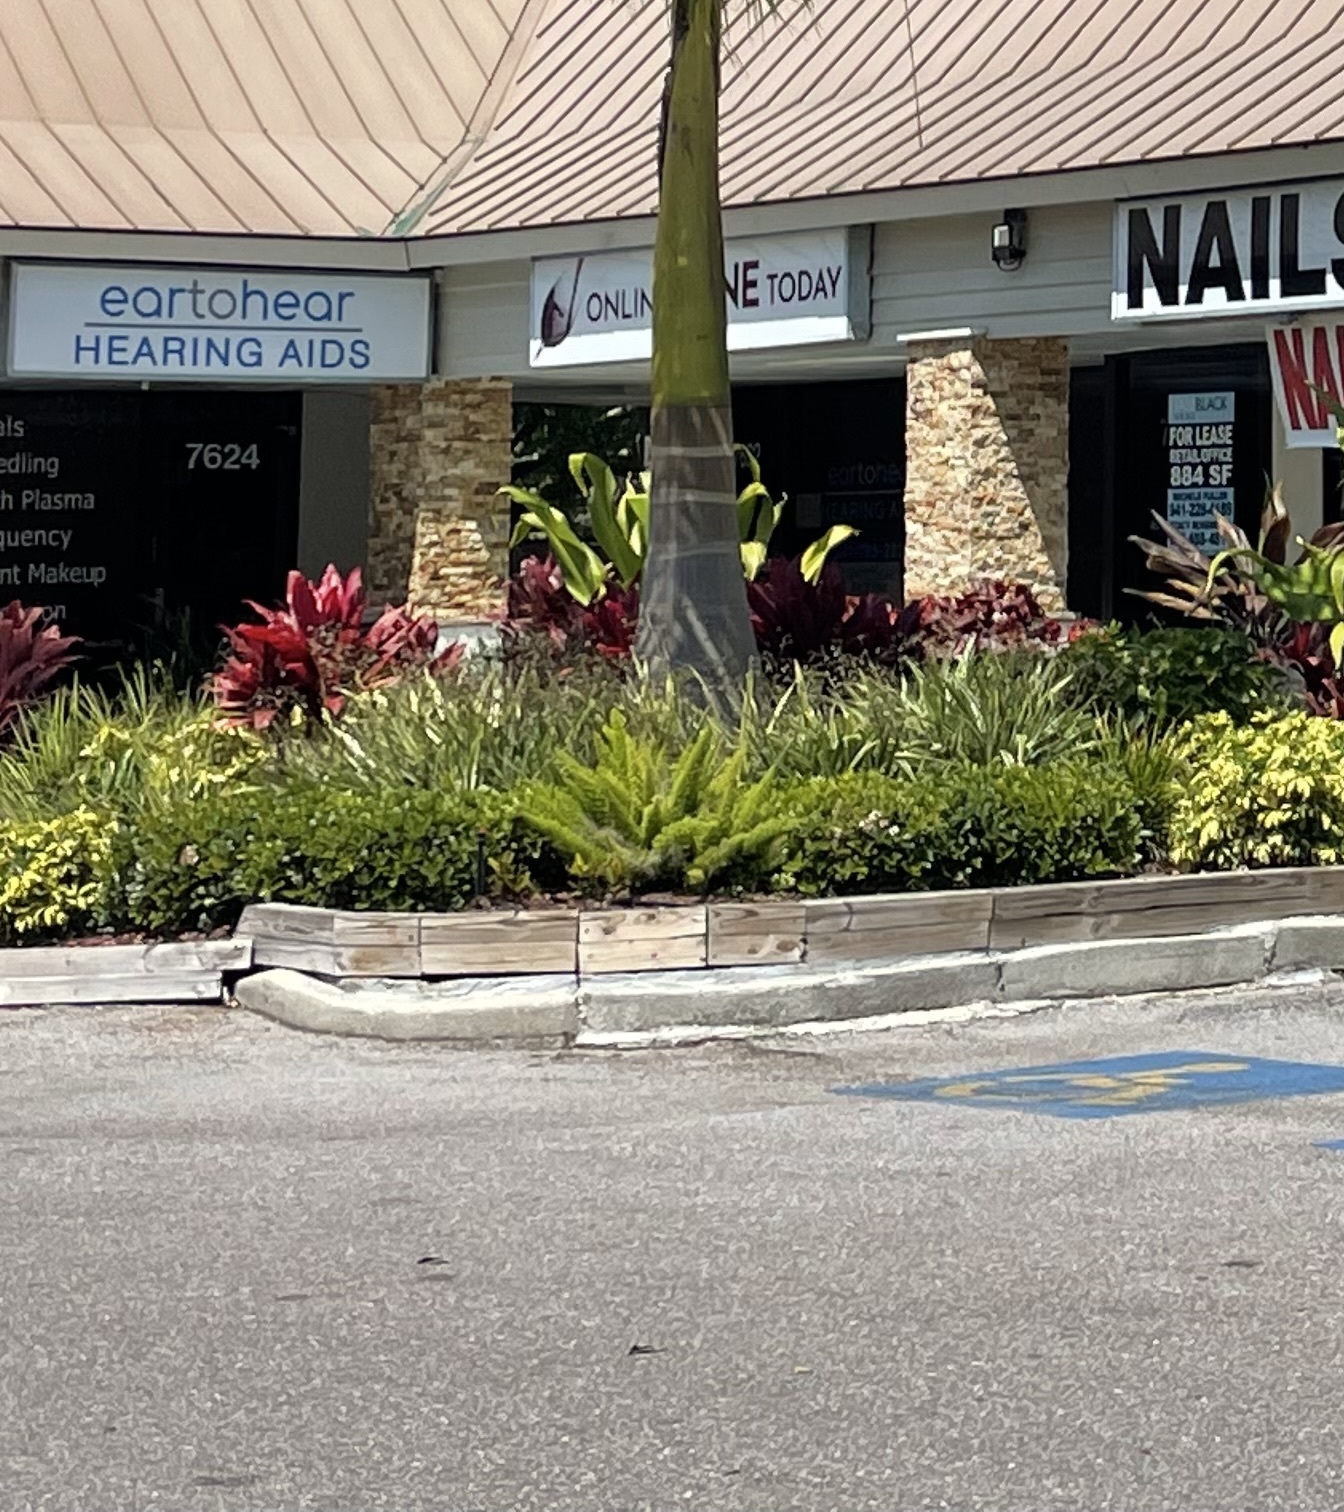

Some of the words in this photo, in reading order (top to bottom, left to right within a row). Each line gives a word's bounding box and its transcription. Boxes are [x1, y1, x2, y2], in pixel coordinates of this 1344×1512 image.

[100, 278, 356, 322] eartohear
[586, 287, 654, 323] ONLIN
[766, 265, 843, 307] TODAY
[73, 333, 263, 368] HEARING
[278, 337, 371, 370] AIDS
[1169, 425, 1194, 447] FOR
[1195, 424, 1234, 446] LEASE
[185, 443, 260, 470] 7624
[1170, 465, 1205, 487] 884
[1208, 464, 1234, 486] SF
[22, 489, 95, 511] Plasma
[28, 562, 107, 588] Makeup
